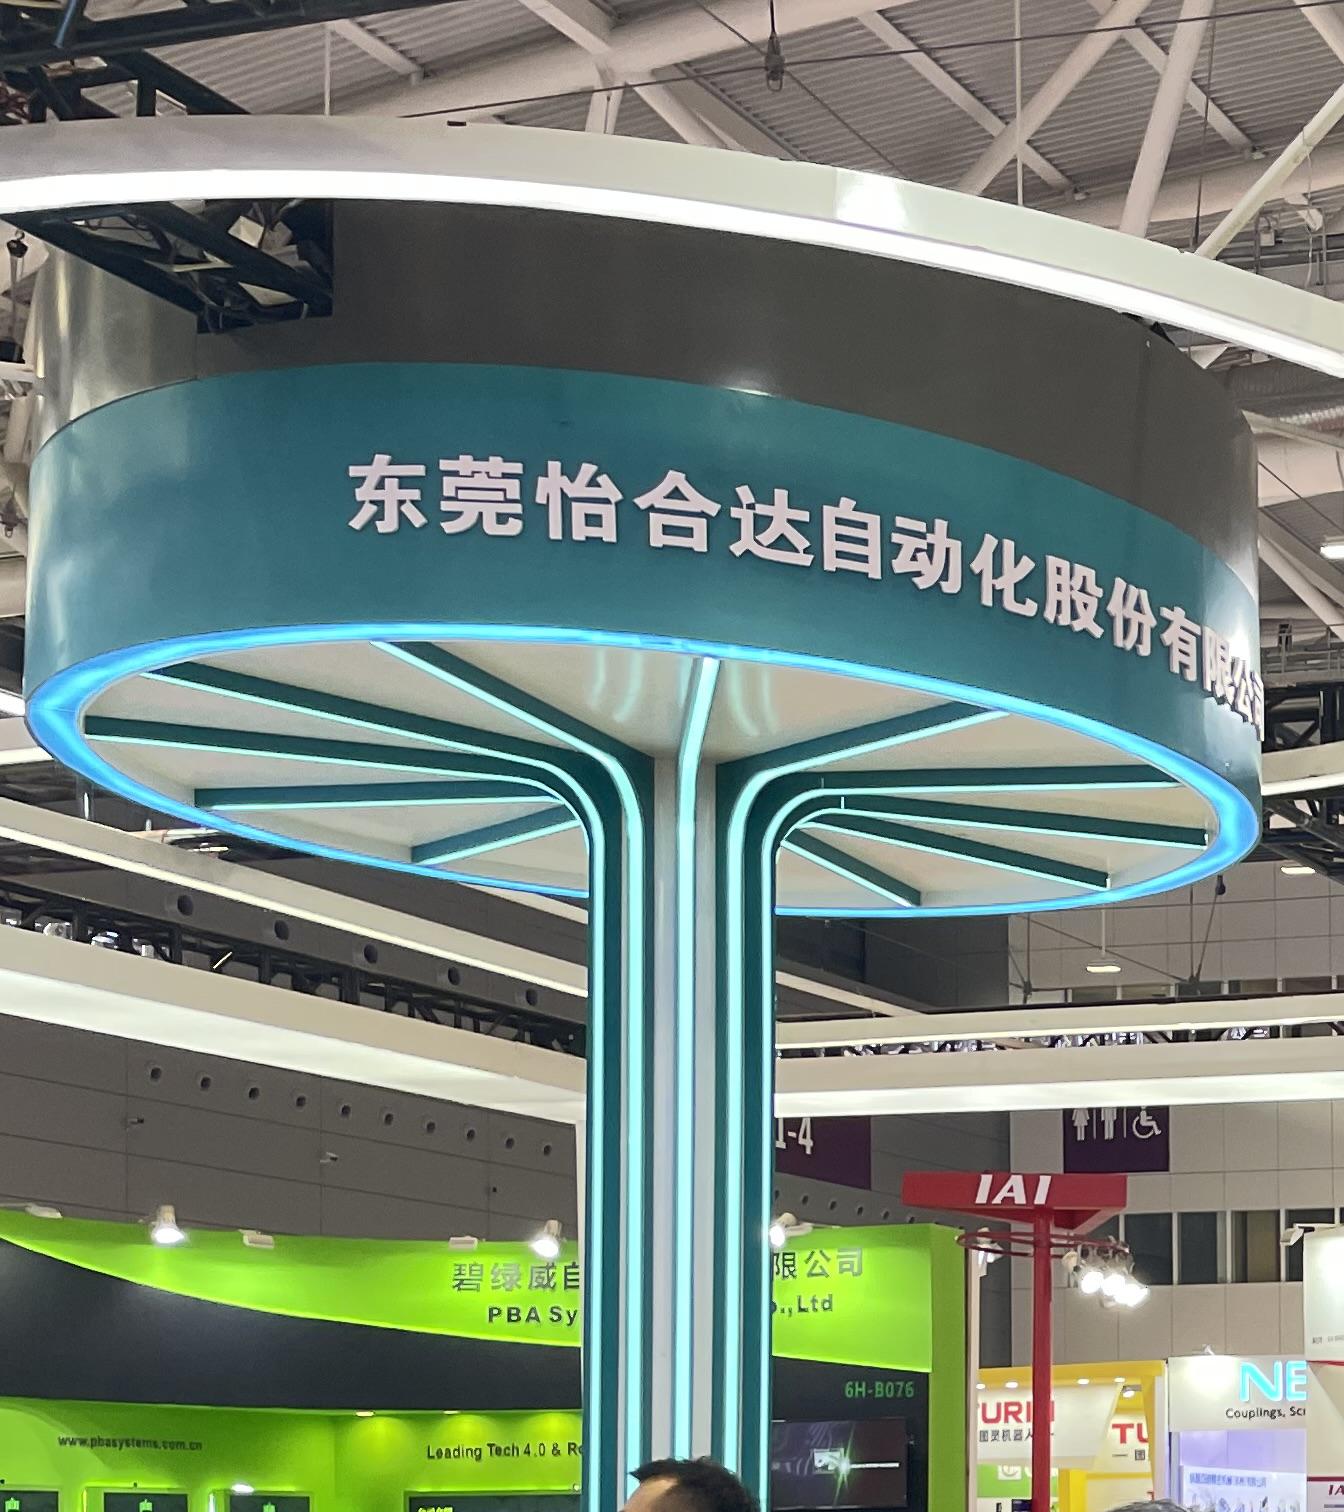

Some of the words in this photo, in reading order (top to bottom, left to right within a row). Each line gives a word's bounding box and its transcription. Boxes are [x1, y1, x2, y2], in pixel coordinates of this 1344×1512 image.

[974, 1174, 1052, 1205] IAI
[452, 1262, 579, 1293] 碧绿威自
[488, 1306, 541, 1324] PBA
[845, 1381, 914, 1398] 6H-B076
[977, 1400, 1055, 1424] URI
[1225, 1408, 1286, 1420] Couplings,
[58, 1435, 202, 1451] www.pbasystems.com.cn
[427, 1445, 482, 1462] Leading
[487, 1443, 519, 1457] Tech
[523, 1442, 546, 1458] 4.0
[551, 1442, 561, 1456] &
